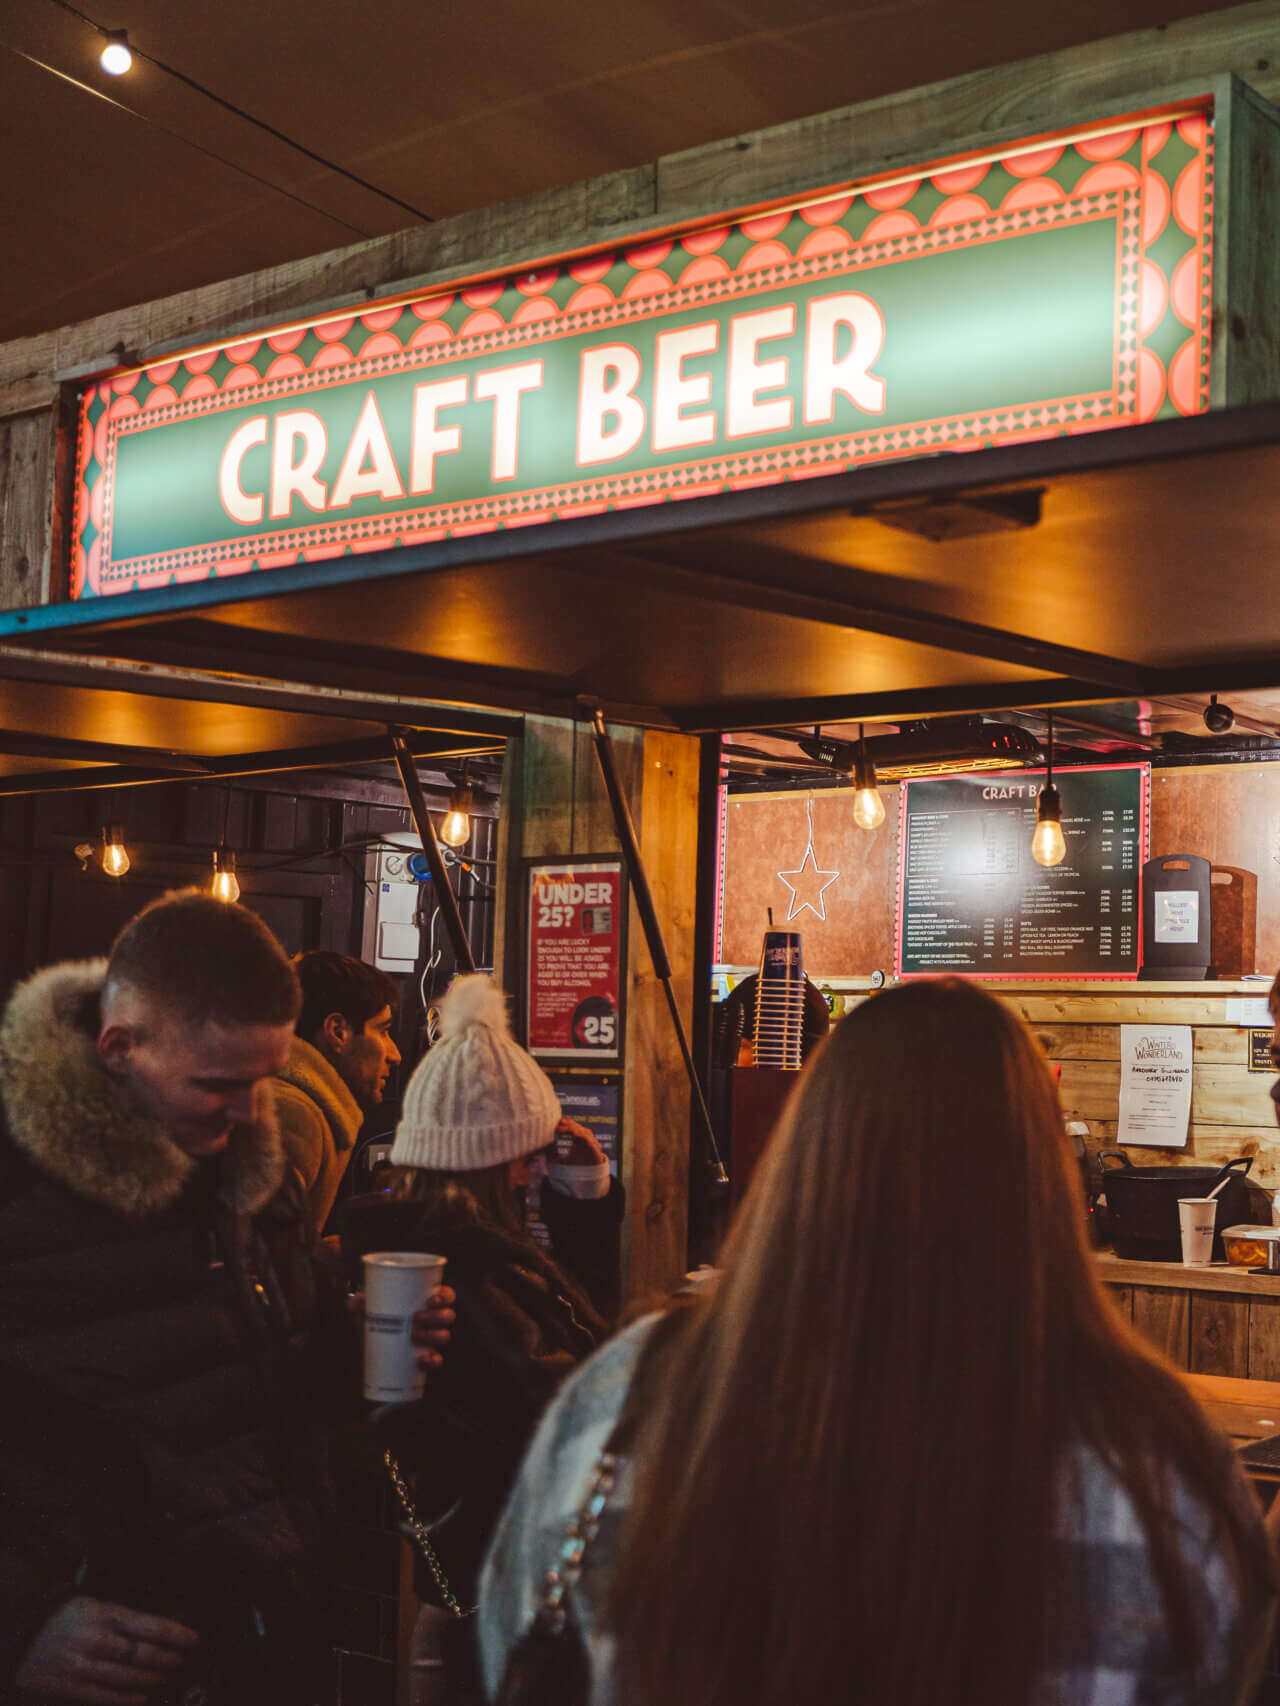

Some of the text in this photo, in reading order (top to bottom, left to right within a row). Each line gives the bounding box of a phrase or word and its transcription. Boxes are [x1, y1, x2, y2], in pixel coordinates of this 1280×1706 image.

[219, 291, 887, 526] CRAFT BEER
[982, 784, 1025, 801] CRAFT
[538, 882, 612, 905] UNDER
[538, 906, 574, 928] 25?
[584, 1016, 614, 1045] 25
